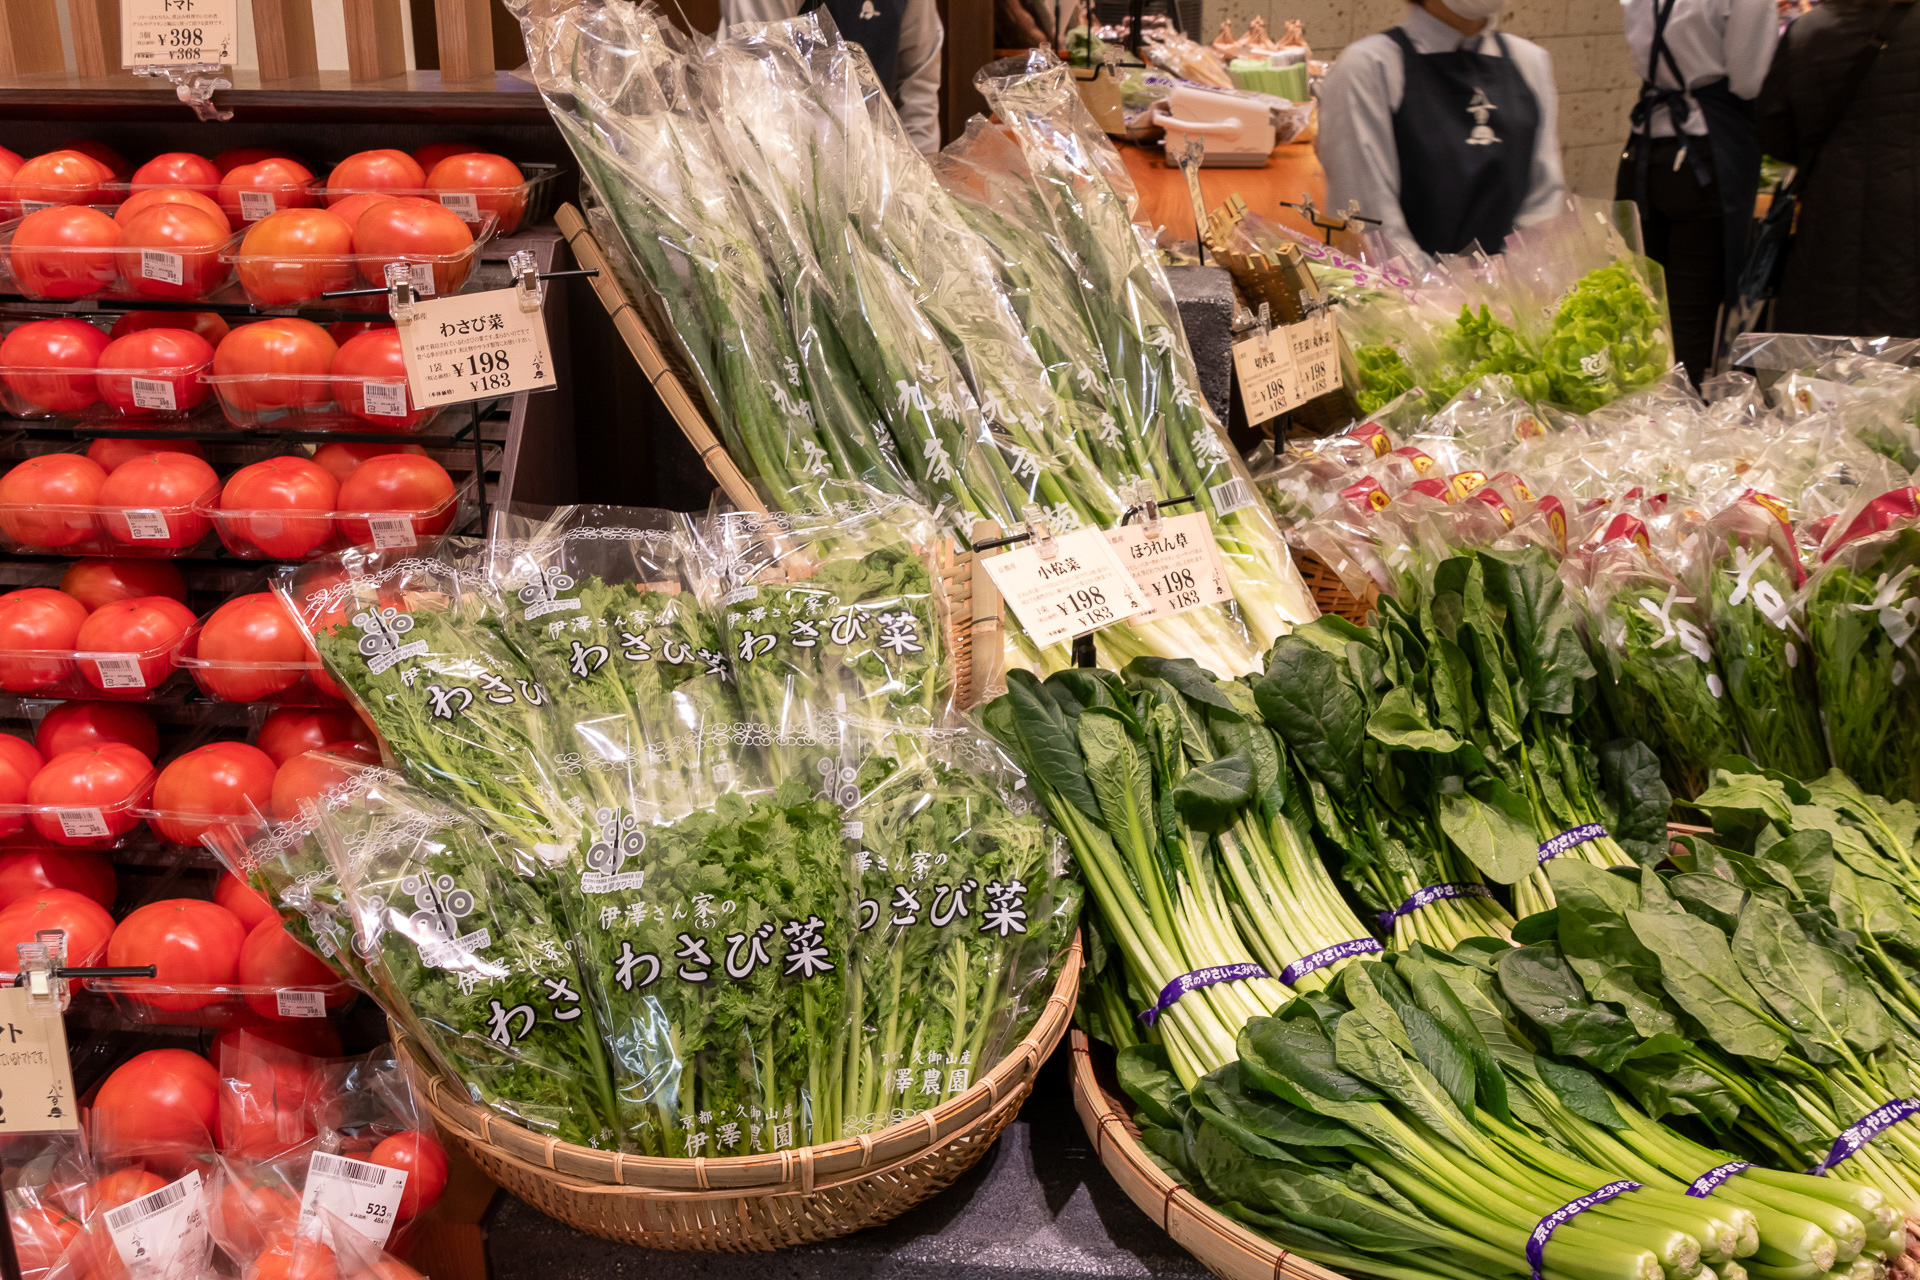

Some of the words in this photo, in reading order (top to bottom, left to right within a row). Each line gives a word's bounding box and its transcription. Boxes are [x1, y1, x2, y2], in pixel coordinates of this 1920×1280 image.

[164, 0, 194, 11] トマト
[158, 28, 203, 46] ¥398
[169, 48, 201, 60] ¥368
[440, 313, 504, 337] わさび菜
[429, 362, 443, 373] 1袋
[452, 349, 510, 378] ¥198
[1305, 361, 1326, 383] ¥198
[470, 372, 511, 392] ¥183
[1260, 378, 1286, 402] ¥198
[1130, 533, 1188, 559] ほうれん草
[1038, 557, 1081, 580] 小松菜
[1151, 568, 1195, 596] ¥198
[1056, 585, 1106, 616] ¥198
[1169, 590, 1200, 610] ¥183
[1078, 606, 1114, 627] ¥183
[738, 610, 925, 663] わさび菜
[599, 892, 736, 930] 伊澤さん家の
[614, 915, 836, 992] わさび菜
